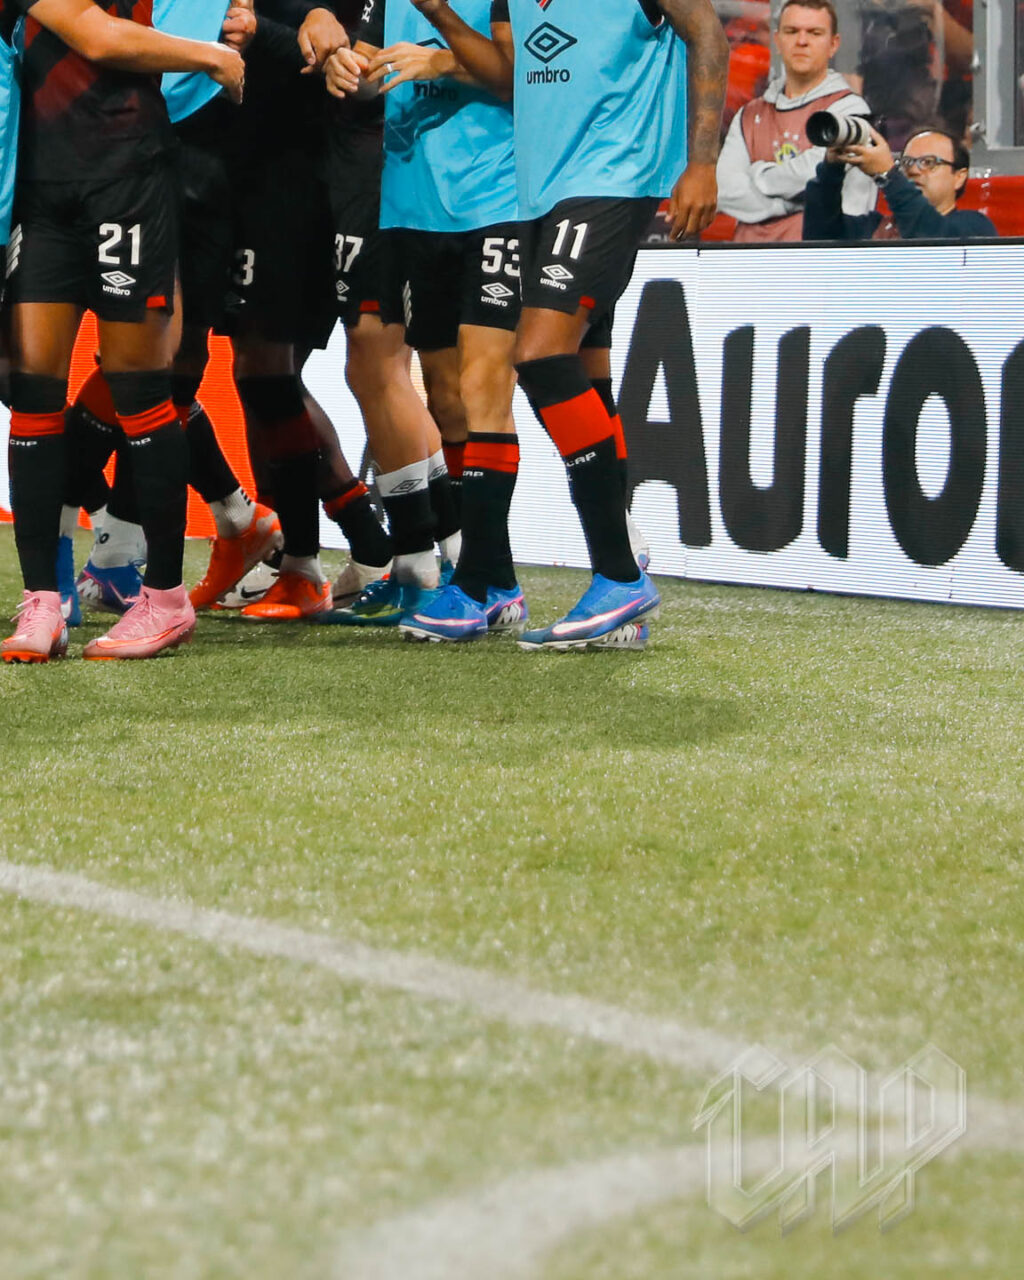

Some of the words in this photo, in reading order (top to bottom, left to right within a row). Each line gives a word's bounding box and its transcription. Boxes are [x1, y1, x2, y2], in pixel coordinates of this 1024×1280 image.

[526, 66, 570, 84] umbro
[414, 82, 459, 101] mbro
[98, 223, 141, 265] 21
[552, 219, 588, 260] 11
[481, 237, 521, 277] 53
[102, 284, 131, 297] umbro
[540, 277, 567, 290] umbro
[481, 295, 508, 307] umbro
[129, 437, 152, 447] AP
